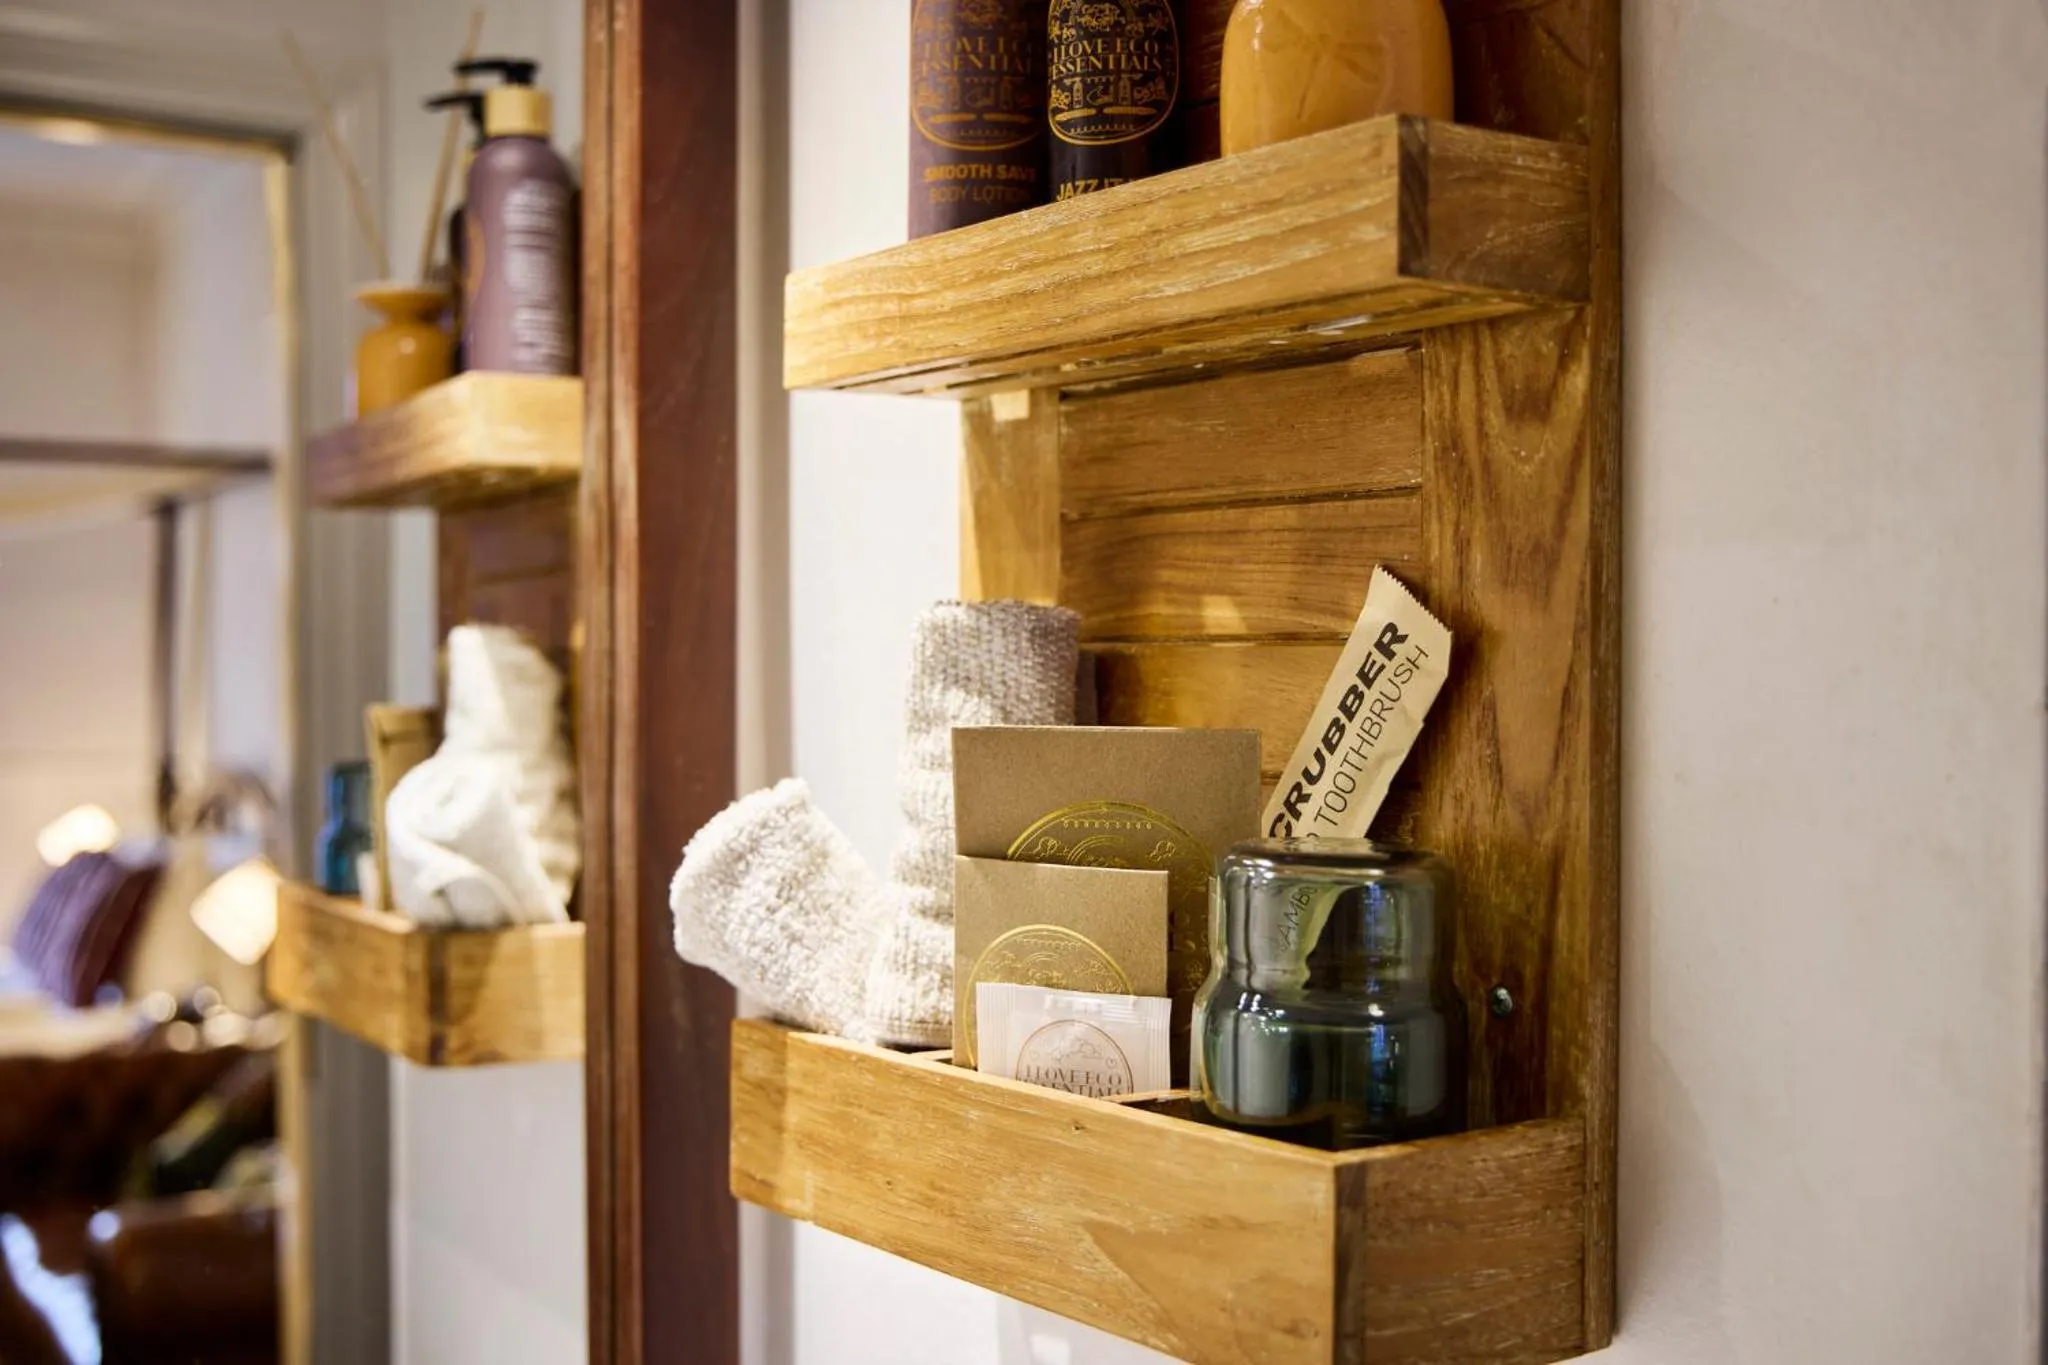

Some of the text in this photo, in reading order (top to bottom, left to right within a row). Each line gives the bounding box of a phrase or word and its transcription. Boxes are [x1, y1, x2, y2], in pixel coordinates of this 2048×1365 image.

[1060, 37, 1109, 60] LOVE
[1115, 37, 1160, 55] ECO
[920, 53, 1034, 76] ESSENTIAL
[1051, 54, 1163, 80] ESSENTIALS
[924, 163, 993, 182] SMOOTH
[930, 186, 967, 203] BODY
[1056, 178, 1100, 202] JAZZ
[1267, 620, 1410, 839] CRUBBER
[1313, 643, 1431, 828] TOOTHBRUSH
[1036, 1065, 1077, 1083] LOVE
[1084, 1070, 1122, 1085] ECO
